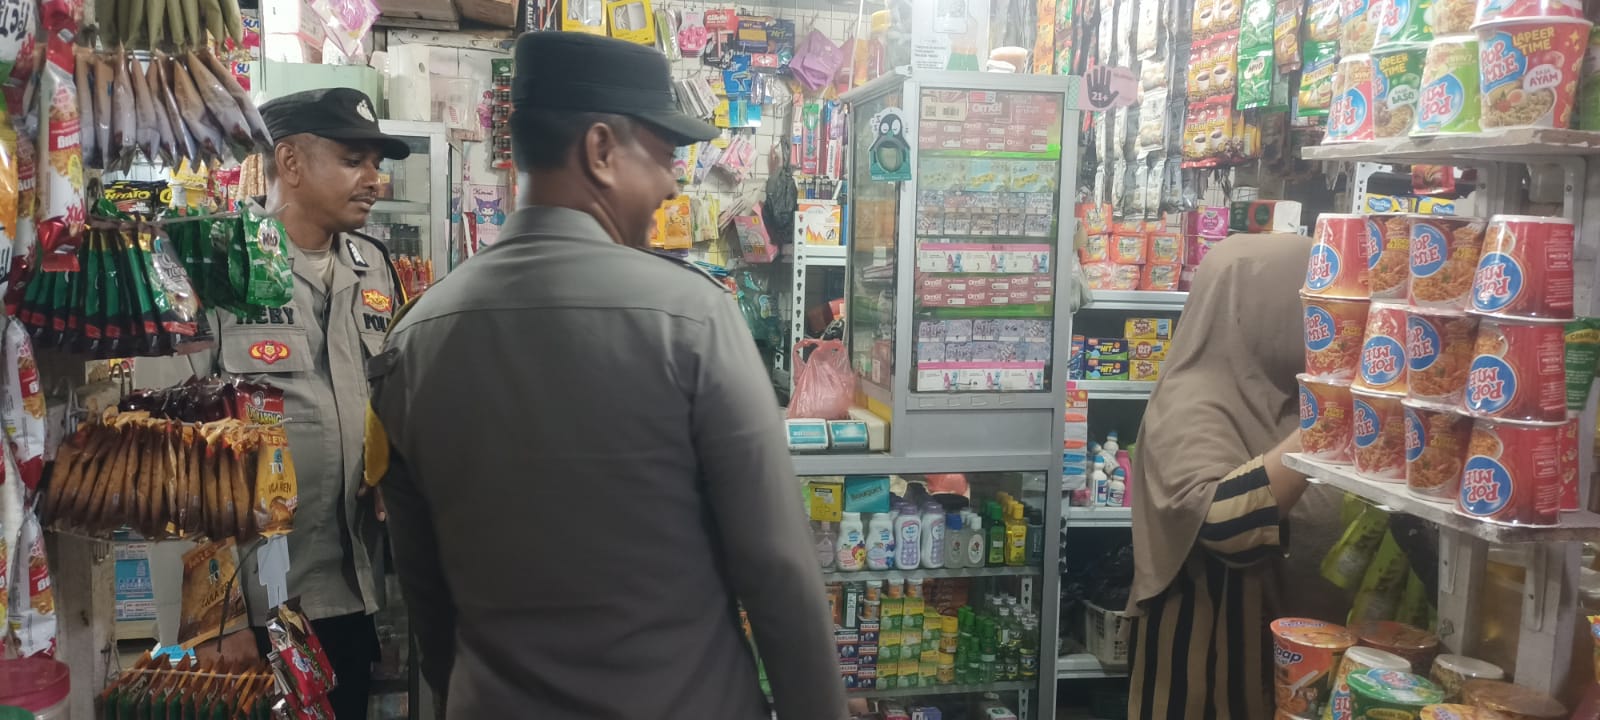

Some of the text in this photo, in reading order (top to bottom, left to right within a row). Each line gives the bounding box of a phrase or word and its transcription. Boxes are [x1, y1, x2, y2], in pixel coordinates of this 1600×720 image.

[1512, 26, 1555, 46] LAPEER
[1481, 40, 1506, 66] POP
[1519, 39, 1552, 56] TIME
[1382, 62, 1408, 78] TIME
[1484, 51, 1520, 84] MIE
[1529, 72, 1559, 87] AYAM
[1091, 91, 1109, 102] 21+
[1422, 95, 1452, 121] POP
[1411, 234, 1431, 254] POP
[1413, 245, 1441, 266] MIE
[1310, 262, 1332, 281] POP
[1476, 263, 1505, 287] MIE
[1479, 276, 1510, 300] POP
[1305, 314, 1321, 330] POP
[1308, 323, 1330, 342] MIE
[1365, 345, 1391, 363] MIE
[1368, 356, 1396, 375] POP
[1470, 366, 1500, 387] MIE
[1472, 380, 1505, 402] POP
[1464, 468, 1495, 488] MIE
[1467, 482, 1501, 503] POP
